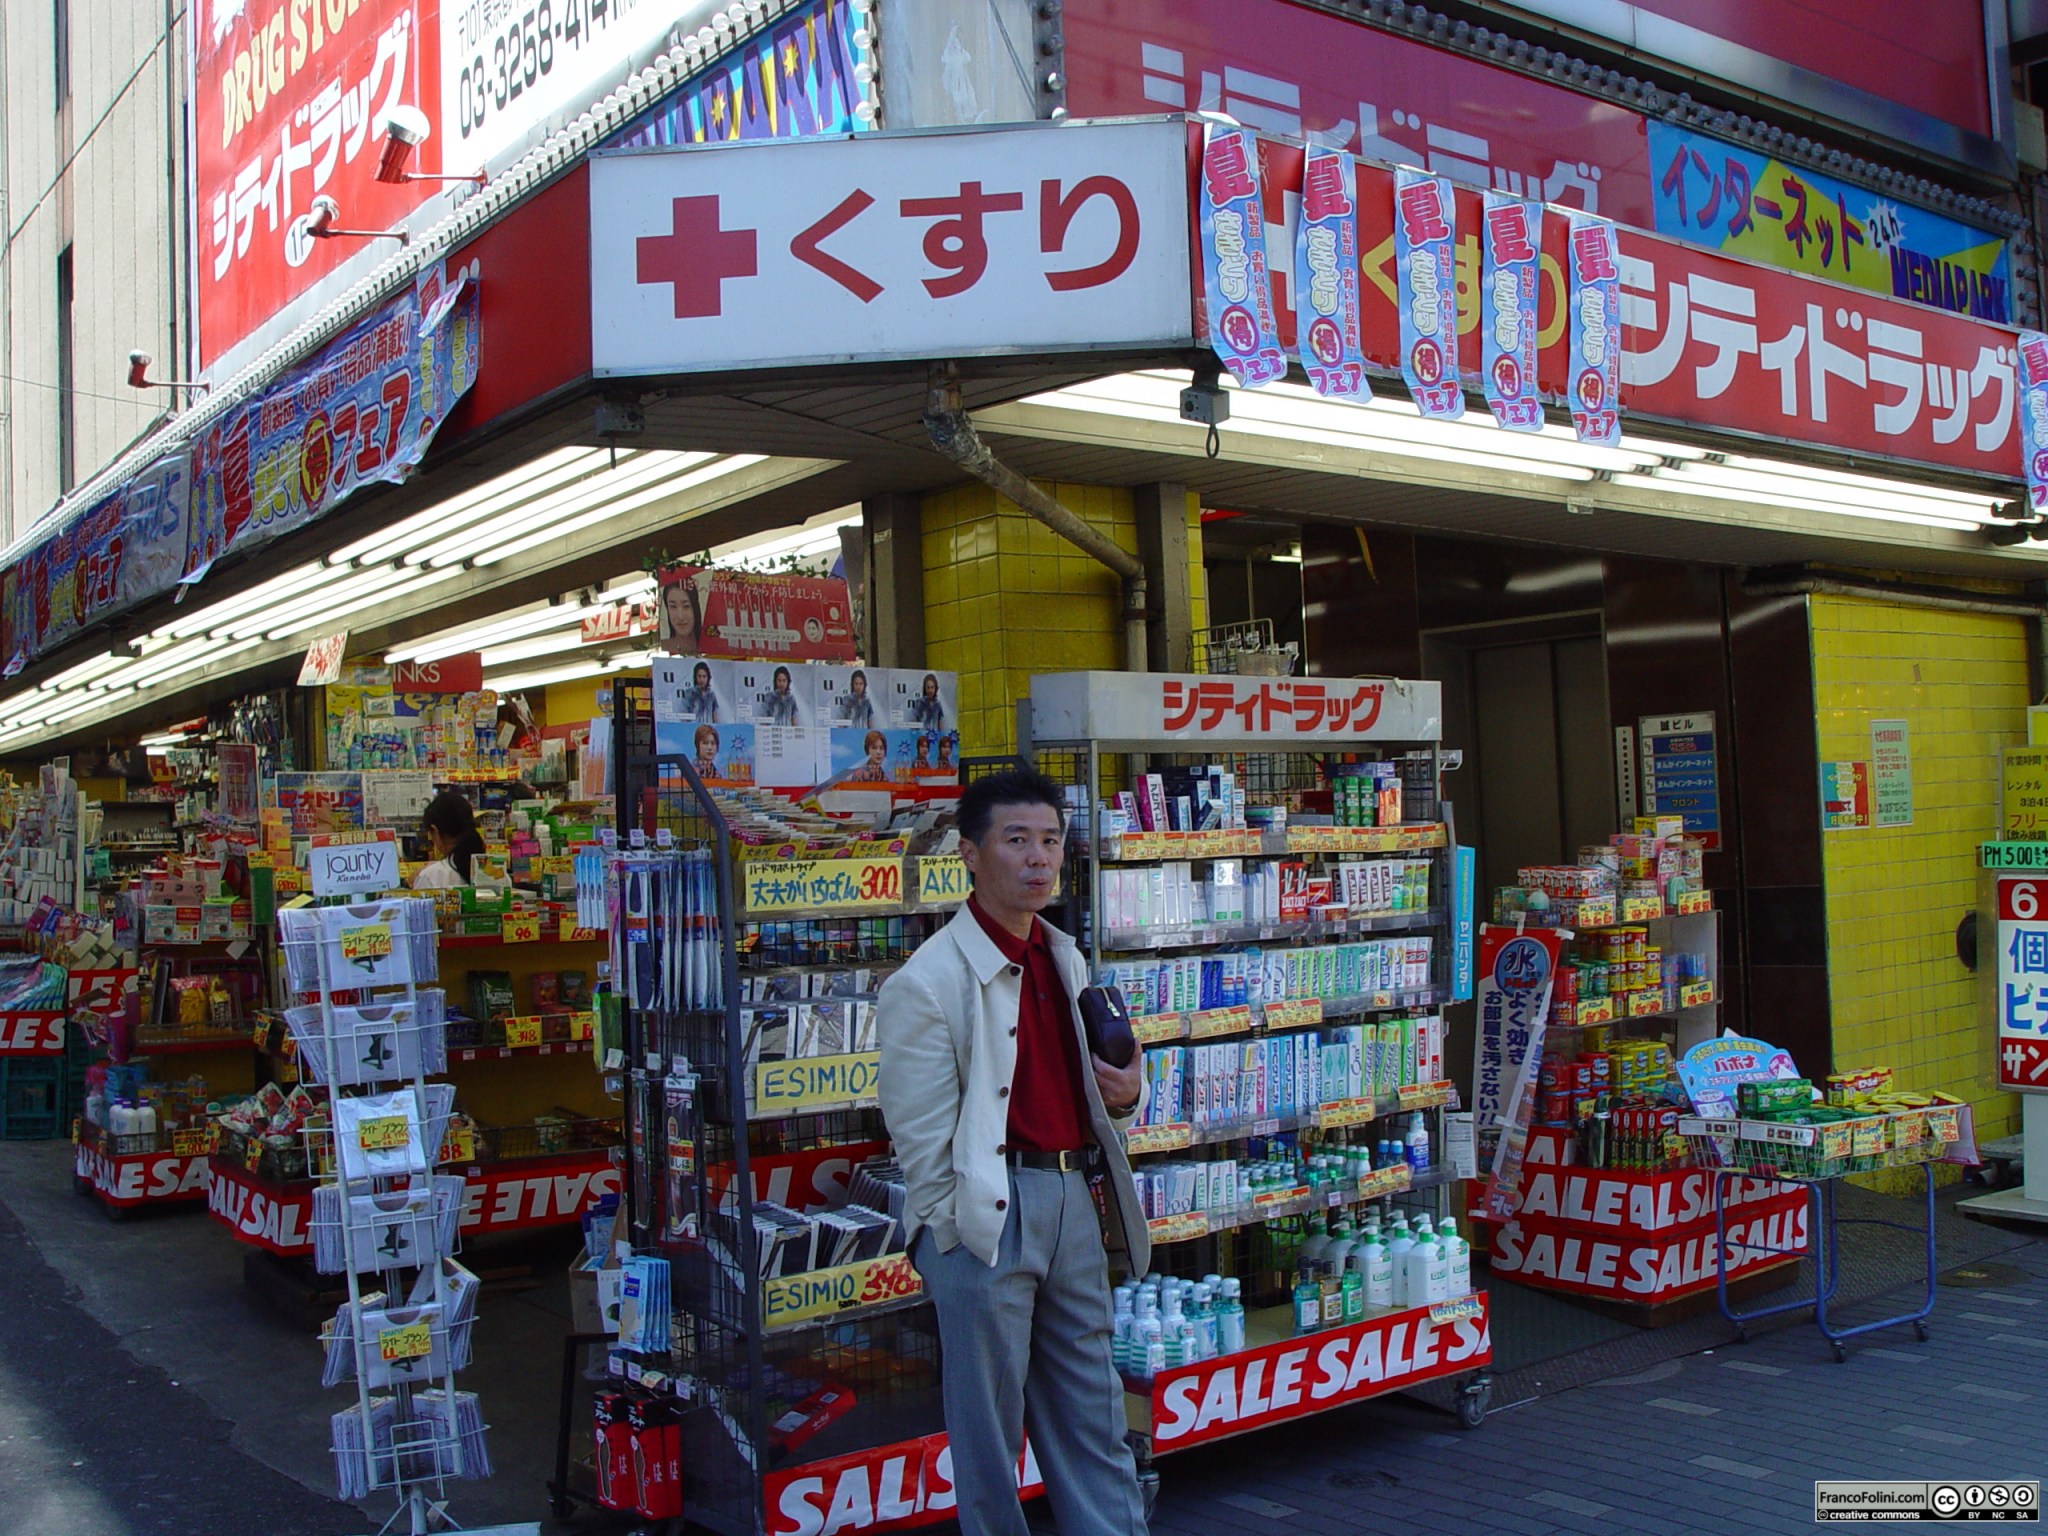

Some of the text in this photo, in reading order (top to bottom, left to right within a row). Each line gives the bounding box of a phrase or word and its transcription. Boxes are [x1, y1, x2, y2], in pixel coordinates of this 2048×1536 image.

[222, 5, 285, 150] DRUG
[213, 9, 411, 282] シティドラッグ
[1206, 132, 1256, 206] 夏
[1305, 155, 1352, 222] 夏
[1400, 181, 1450, 247] 夏
[1661, 143, 1865, 272] インターネット
[790, 175, 1140, 304] くすり
[1487, 204, 1535, 266] 夏
[1572, 225, 1616, 285] 夏
[1619, 257, 2017, 452] シティドラッグ
[332, 367, 411, 490] フェア
[583, 604, 632, 638] SALE
[1163, 681, 1384, 733] シティドラッグ
[2008, 781, 2041, 791] レンタル
[326, 849, 384, 879] jaunty
[336, 873, 371, 883] Kanebo
[750, 861, 816, 876] ハードサポートタイプ
[1984, 846, 2001, 866] PM
[751, 871, 859, 906] 丈夫がいちばん
[1714, 1055, 1757, 1073] バポナ
[1491, 1232, 1622, 1289] SALE
[1622, 1234, 1721, 1294] SALE
[767, 1274, 855, 1315] ESIMIO
[1156, 1314, 1447, 1442] SALE SALE
